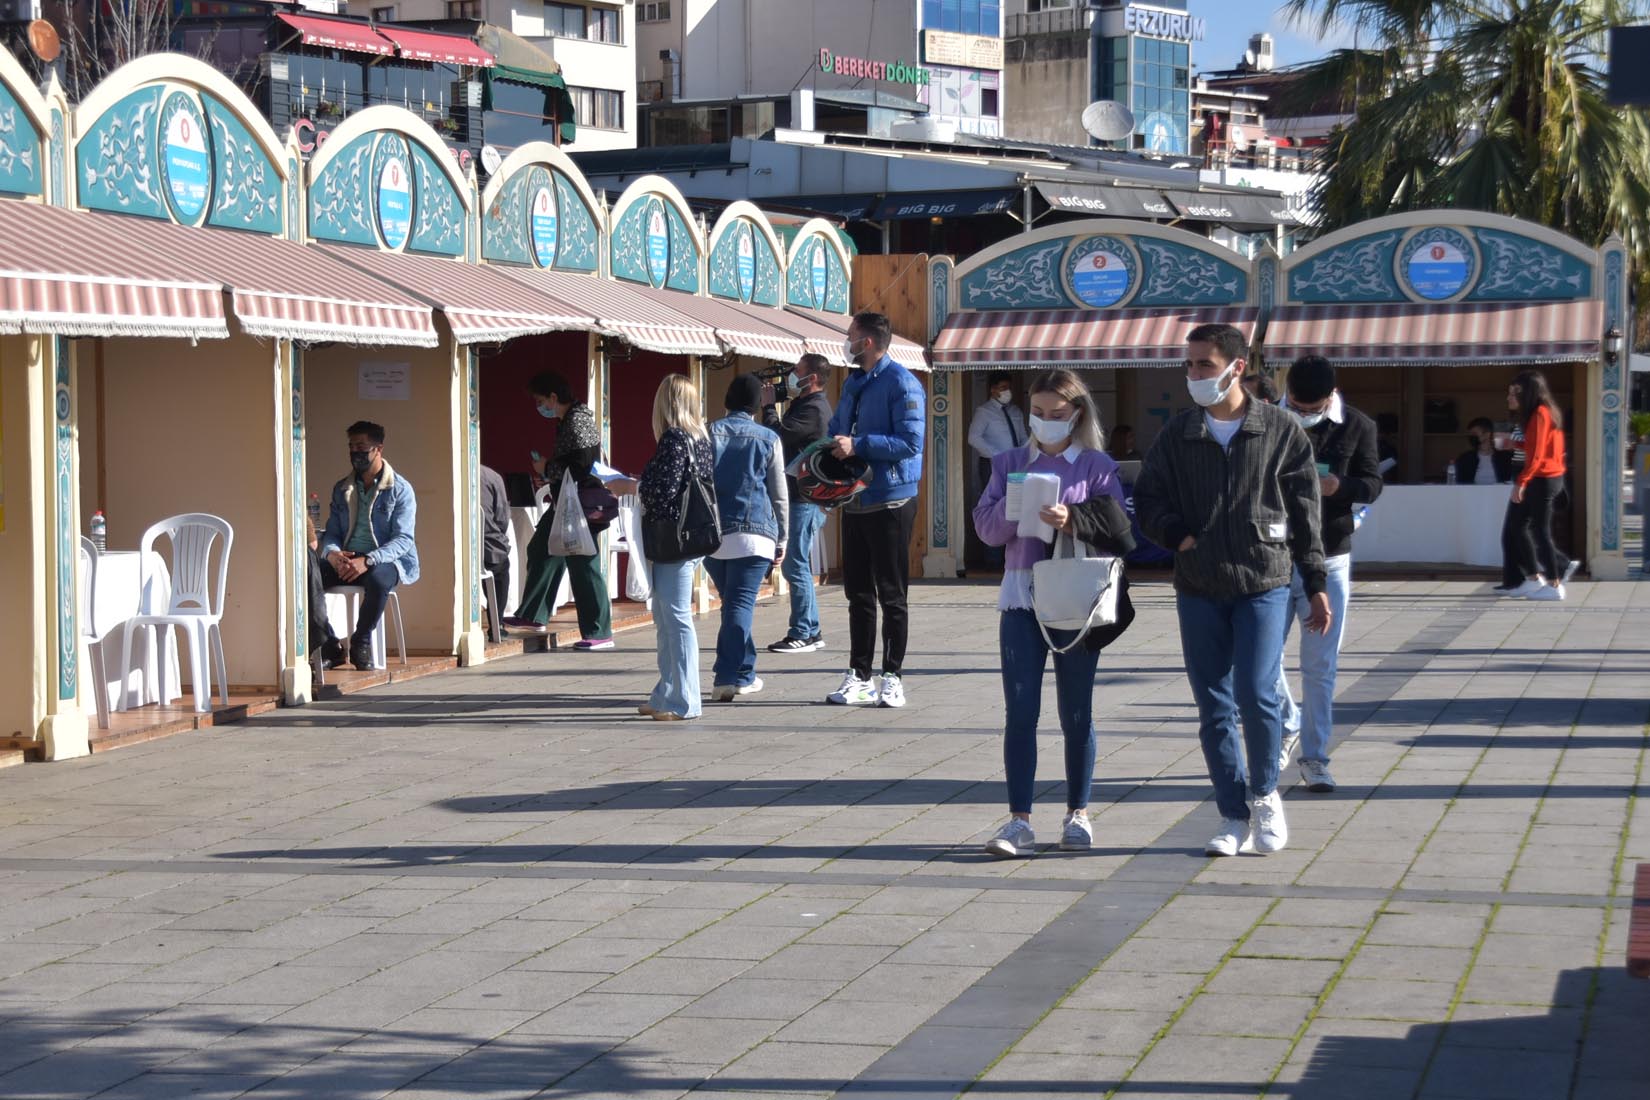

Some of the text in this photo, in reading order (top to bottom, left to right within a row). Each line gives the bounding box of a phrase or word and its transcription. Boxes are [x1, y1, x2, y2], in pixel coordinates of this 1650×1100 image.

[1124, 7, 1206, 41] ERZURUM
[1059, 196, 1106, 209] BIG BIG
[898, 204, 956, 216] BIG BIG
[1187, 207, 1232, 217] BIG BIG
[1095, 257, 1103, 267] 2
